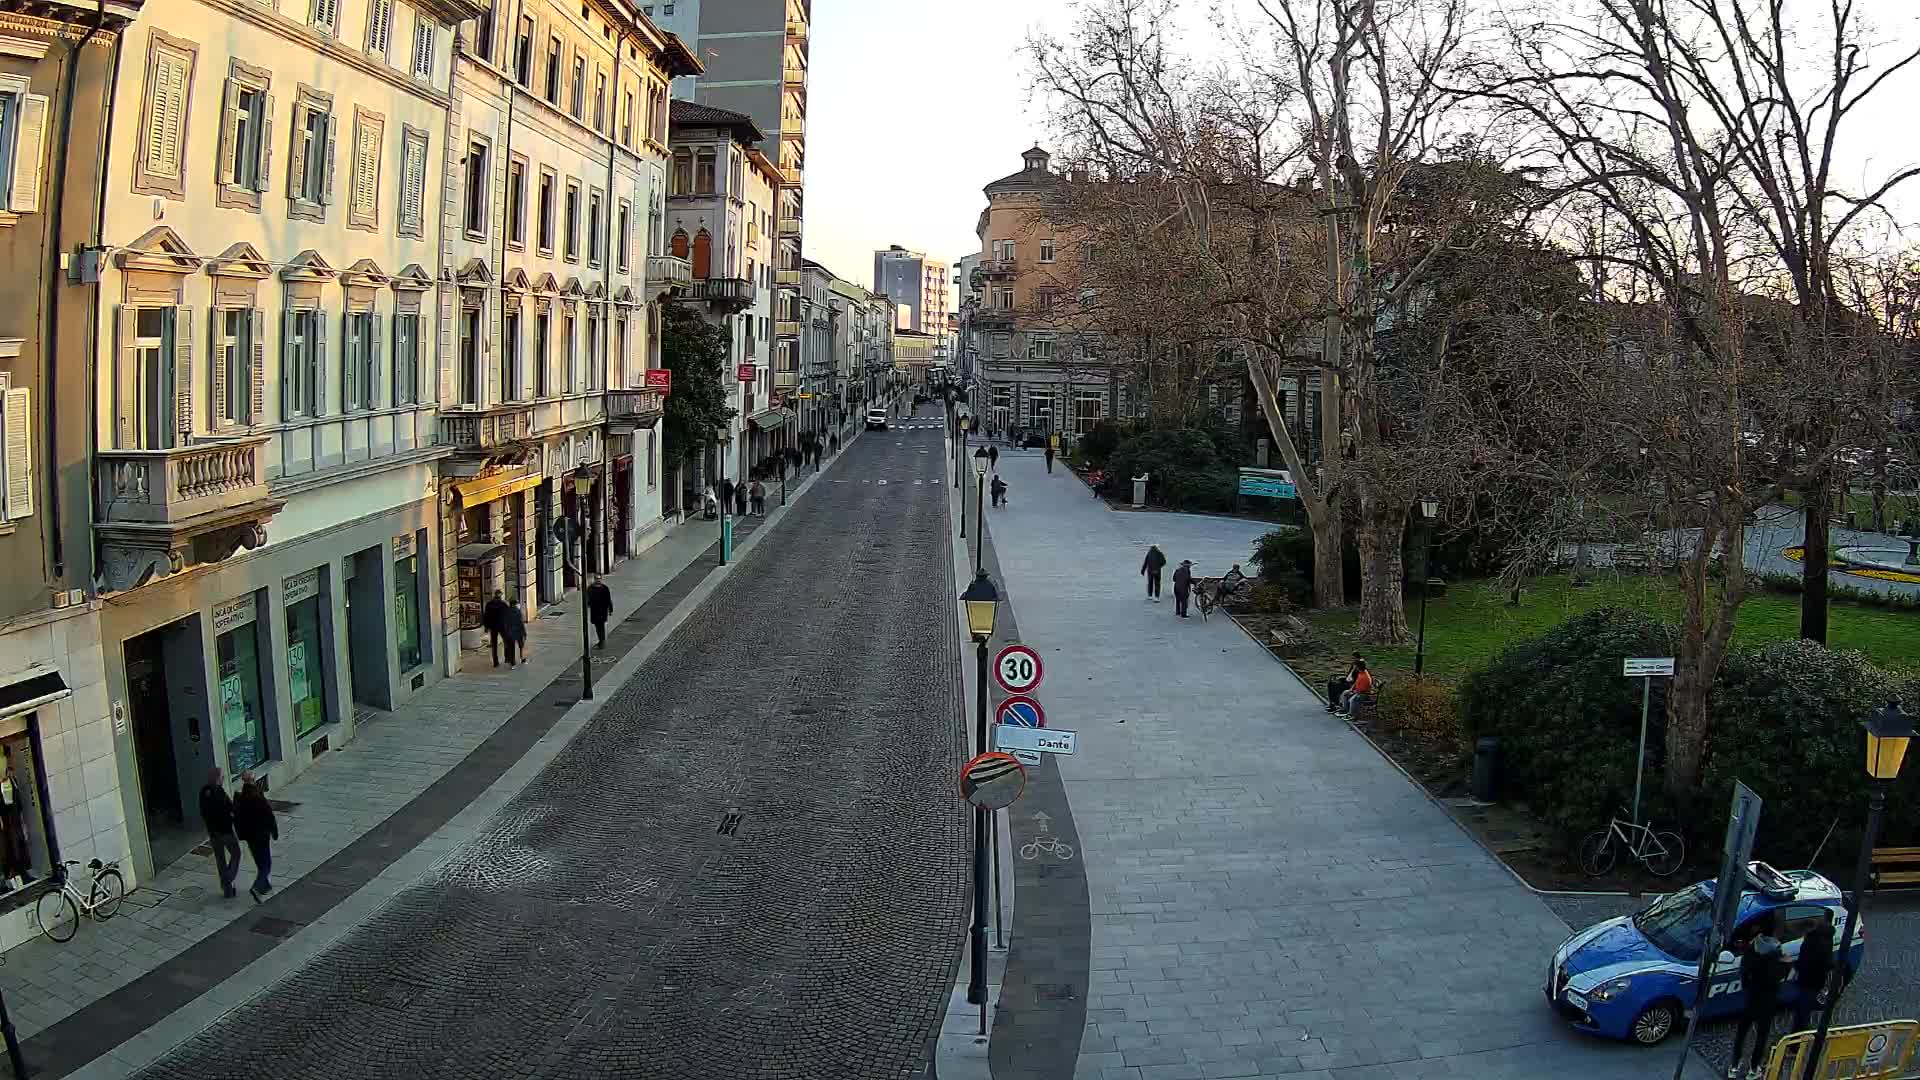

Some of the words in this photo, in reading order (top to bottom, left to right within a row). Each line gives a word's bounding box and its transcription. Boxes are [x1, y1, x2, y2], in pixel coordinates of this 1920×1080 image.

[1005, 659, 1033, 680] 30
[1038, 738, 1070, 750] Dante
[1709, 980, 1742, 998] PO
